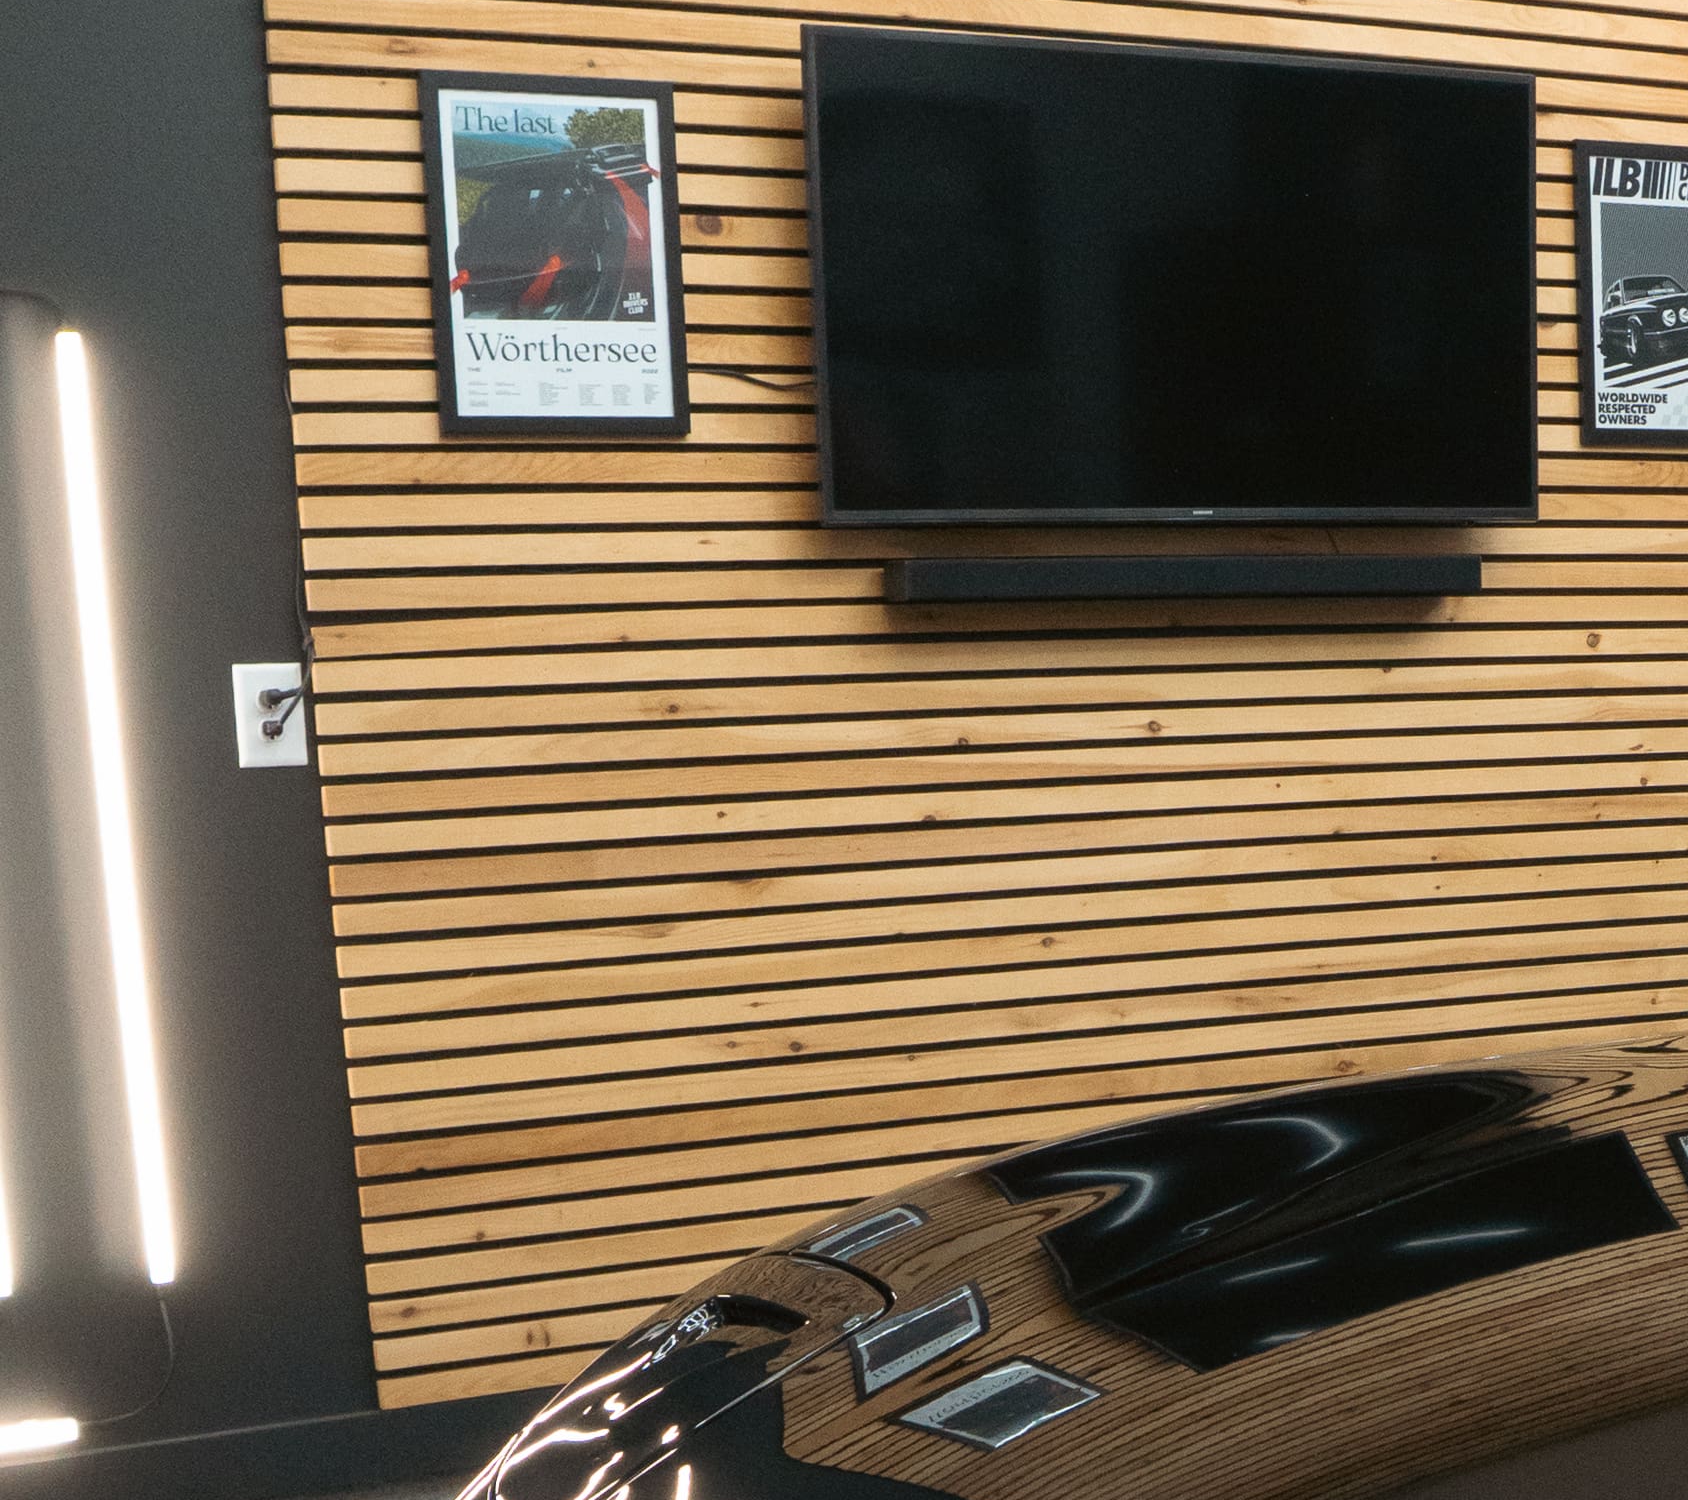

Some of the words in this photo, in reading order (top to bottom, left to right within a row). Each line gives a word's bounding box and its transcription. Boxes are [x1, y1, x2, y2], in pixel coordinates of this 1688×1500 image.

[456, 105, 508, 133] The
[514, 109, 557, 135] last
[465, 332, 657, 363] Wörthersee
[1597, 391, 1669, 405] WORLDWIDE
[1598, 402, 1657, 415] RESPECTED
[1598, 413, 1648, 426] OWNERS
